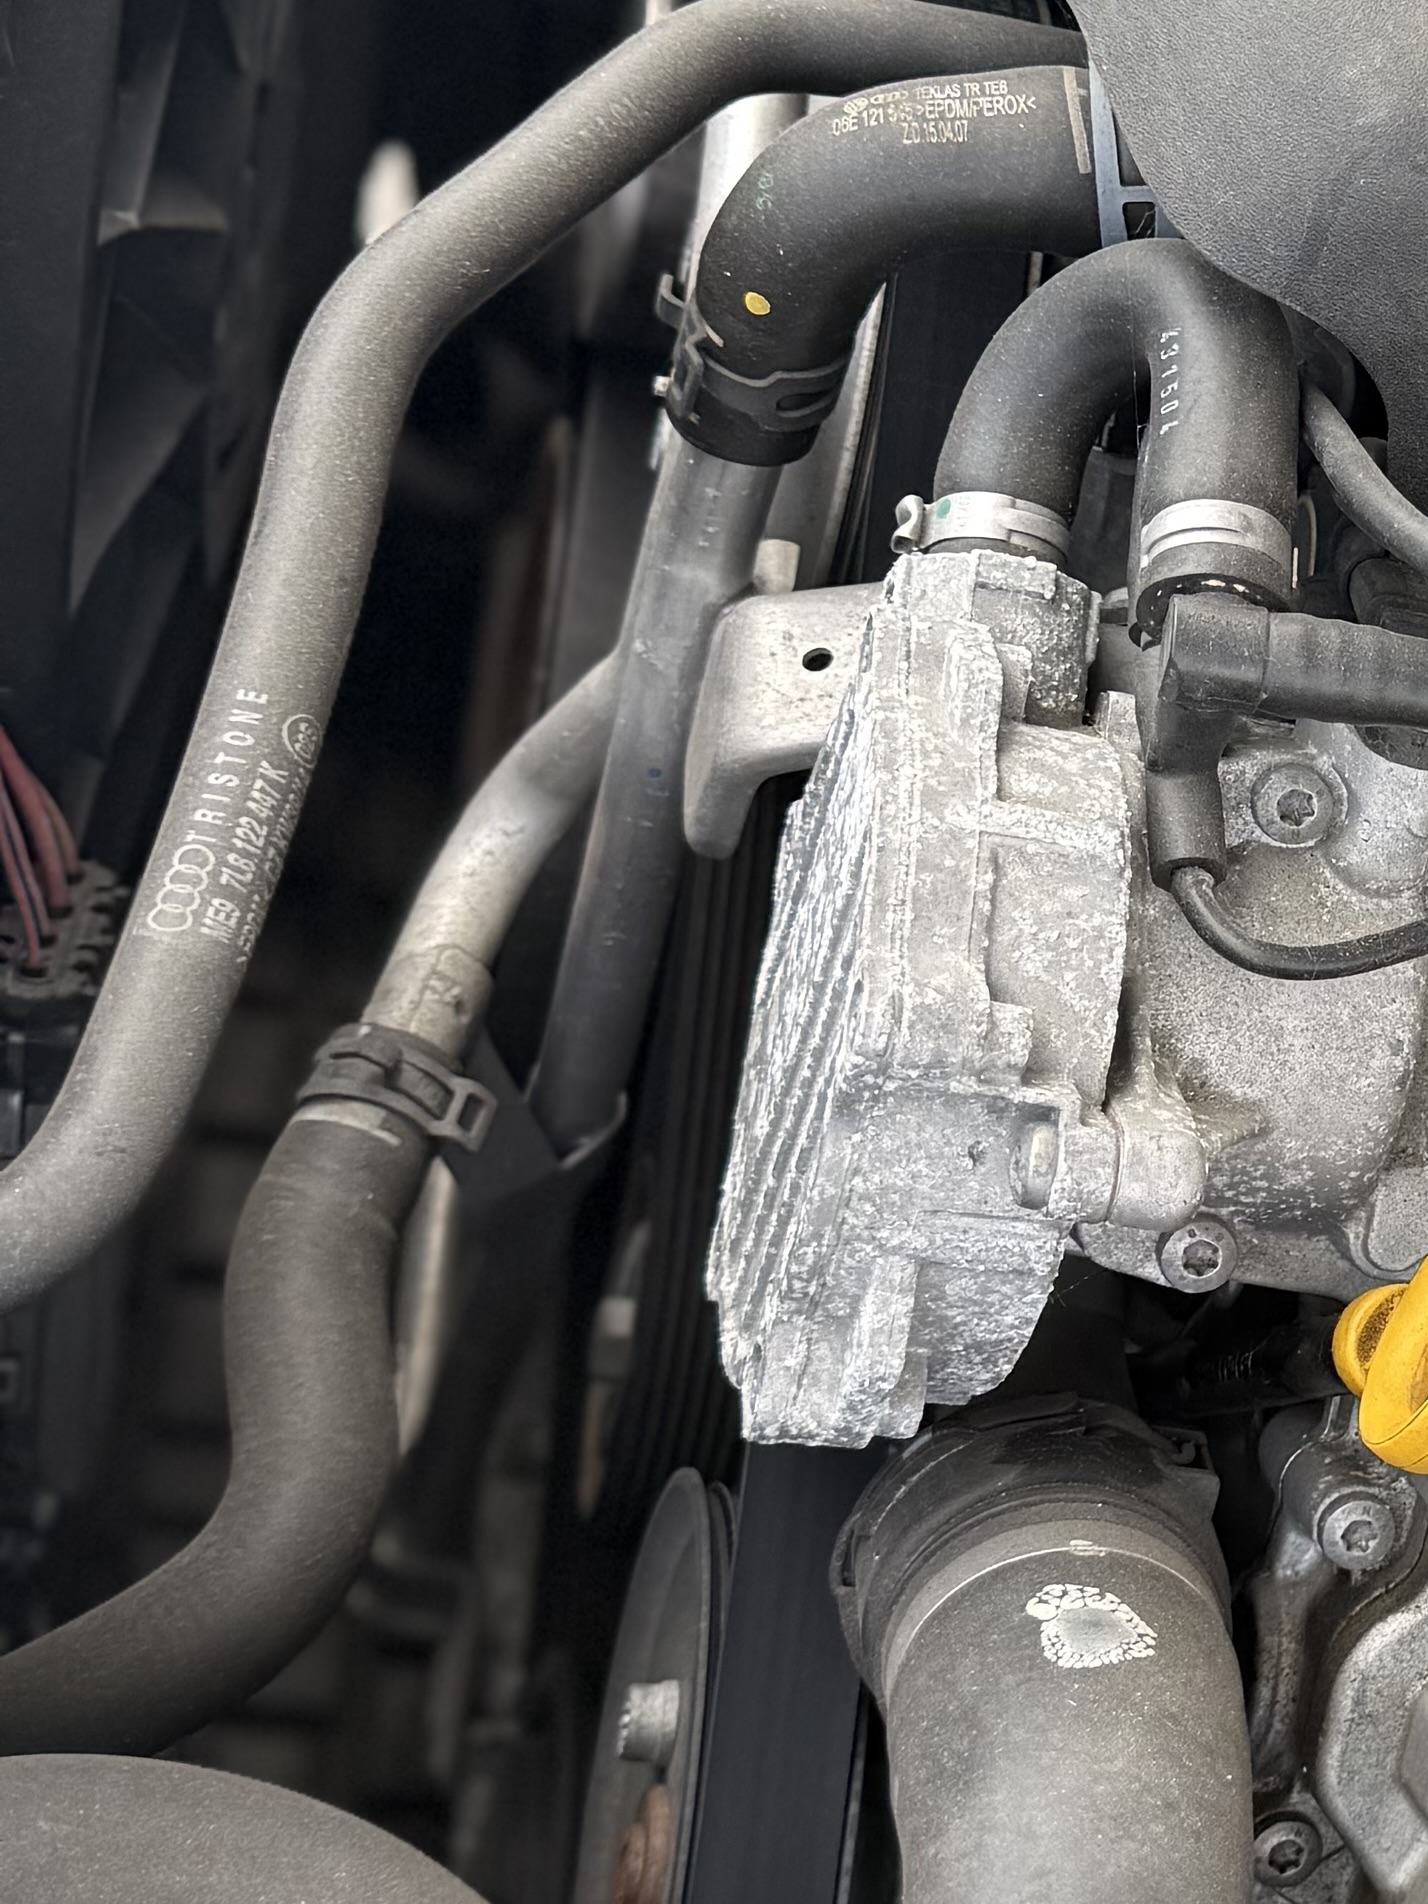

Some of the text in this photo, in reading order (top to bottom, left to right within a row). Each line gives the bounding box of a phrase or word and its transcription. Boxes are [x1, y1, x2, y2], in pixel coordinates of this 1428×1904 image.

[964, 82, 980, 96] TR
[862, 108, 884, 127] 121
[185, 686, 270, 843] TRISTONE
